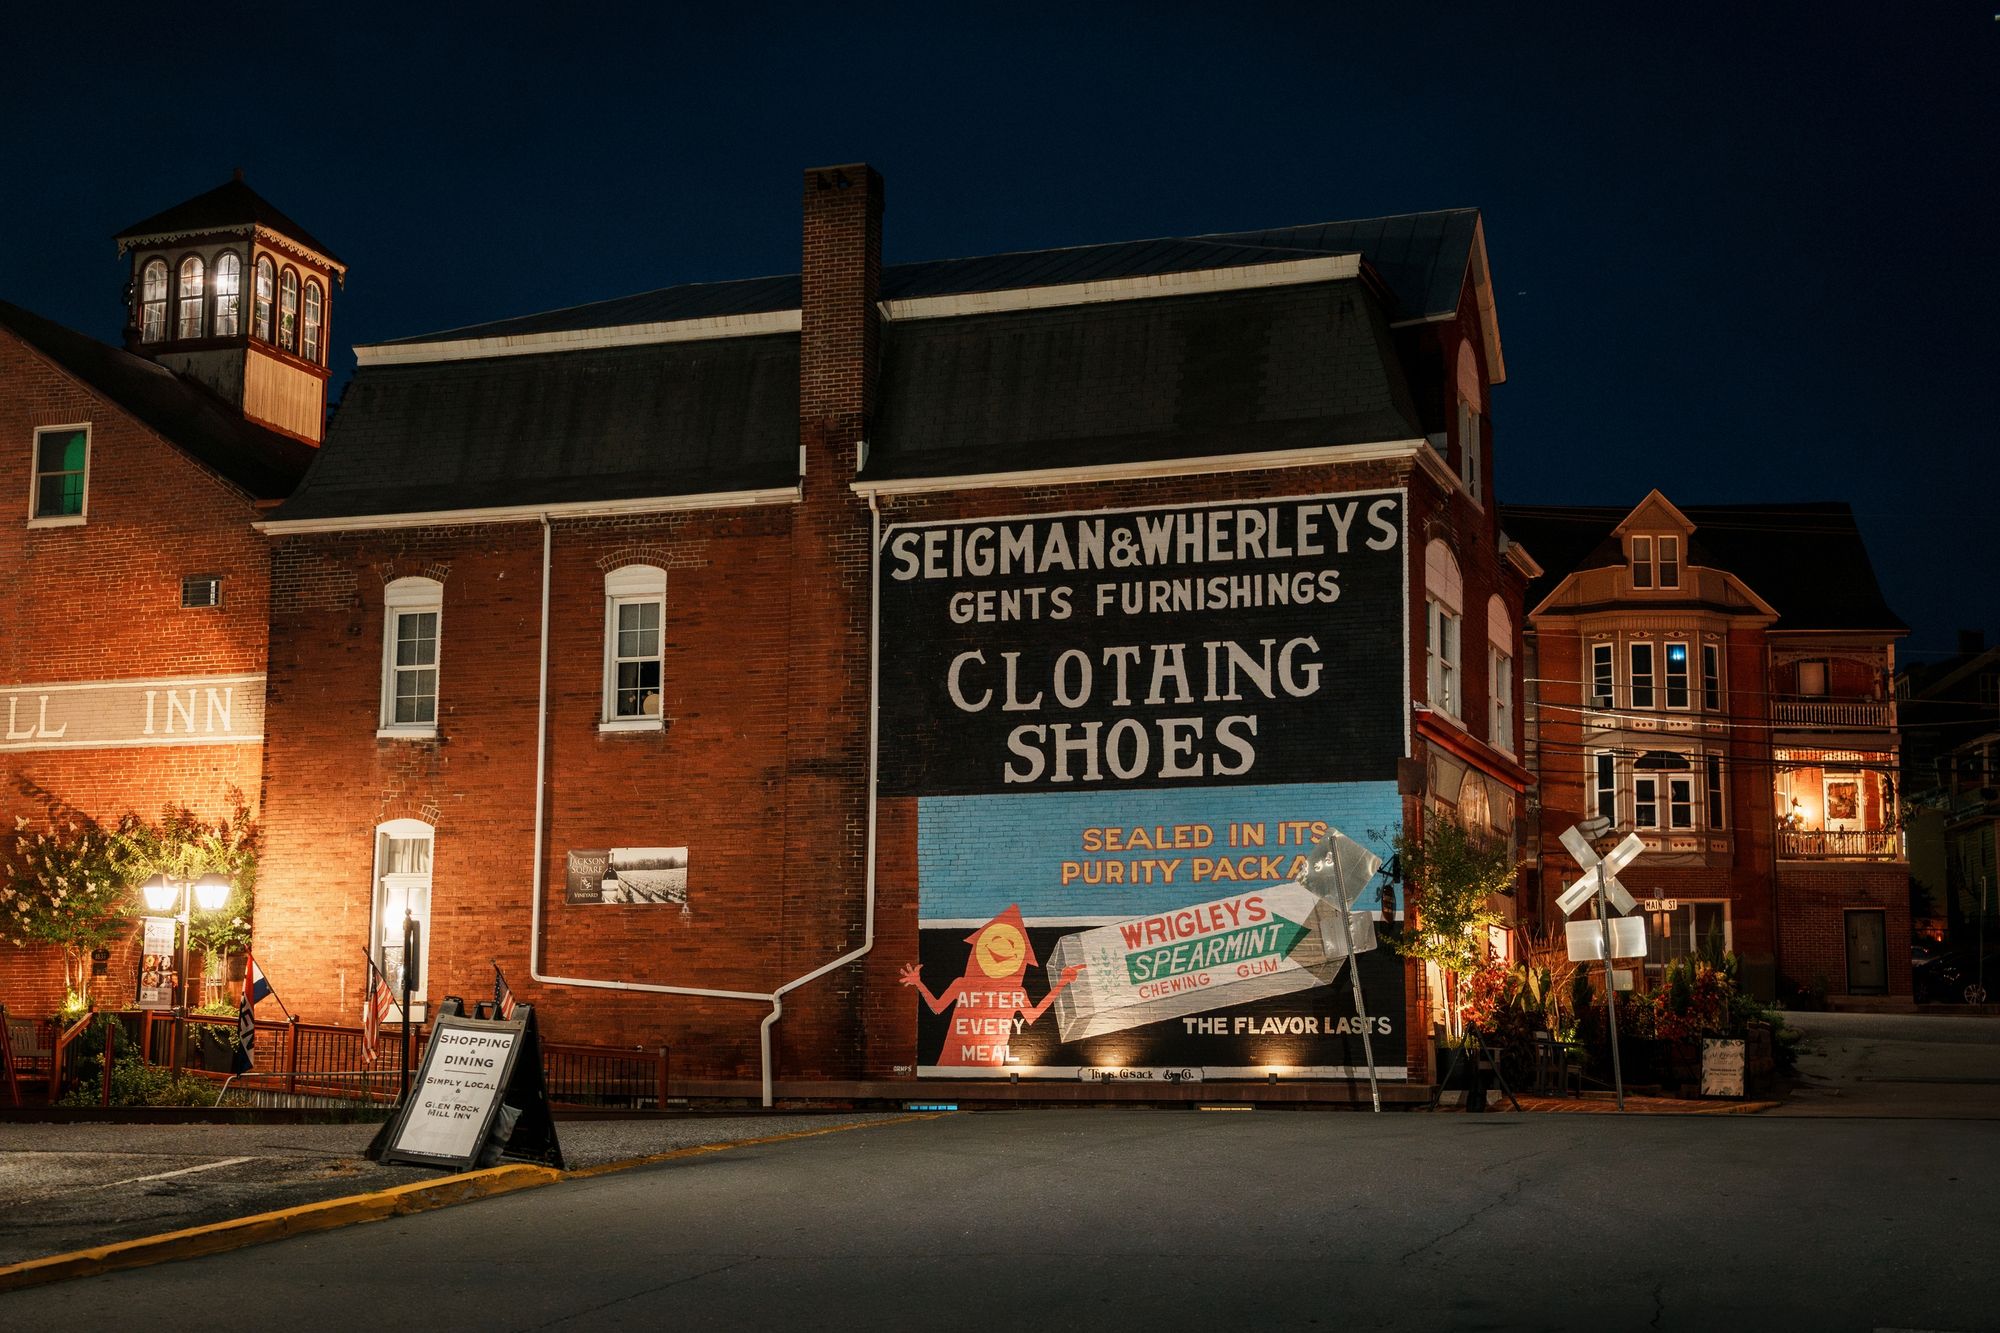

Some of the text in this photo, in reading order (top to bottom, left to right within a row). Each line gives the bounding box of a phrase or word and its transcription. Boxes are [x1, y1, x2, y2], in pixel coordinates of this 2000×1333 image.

[950, 570, 1341, 624] GENTS FURNISHINGS
[143, 687, 233, 734] INN
[1004, 715, 1258, 783] SHOES
[1082, 821, 1330, 852] SEALED IN ITS
[570, 857, 606, 867] JACKSON
[572, 865, 603, 874] SQUARE
[1061, 854, 1309, 886] PURITY PACKA
[1645, 900, 1676, 910] MAIN ST
[1120, 896, 1267, 950] WRIGLEYS
[1133, 922, 1284, 980] SPEARMINT
[1139, 958, 1278, 999] CHEWING GUM
[956, 991, 1025, 1008] AFTER
[956, 1018, 1025, 1035] EVERY
[1182, 1016, 1392, 1035] THE FLAVOR LASTS
[440, 1034, 511, 1049] SHOPPING
[444, 1055, 494, 1068] DINING
[961, 1045, 1020, 1061] MEAL
[427, 1077, 496, 1090] SIMPLY LOCAL
[425, 1101, 480, 1113] GLEN ROCK
[427, 1109, 472, 1120] MILL INN
